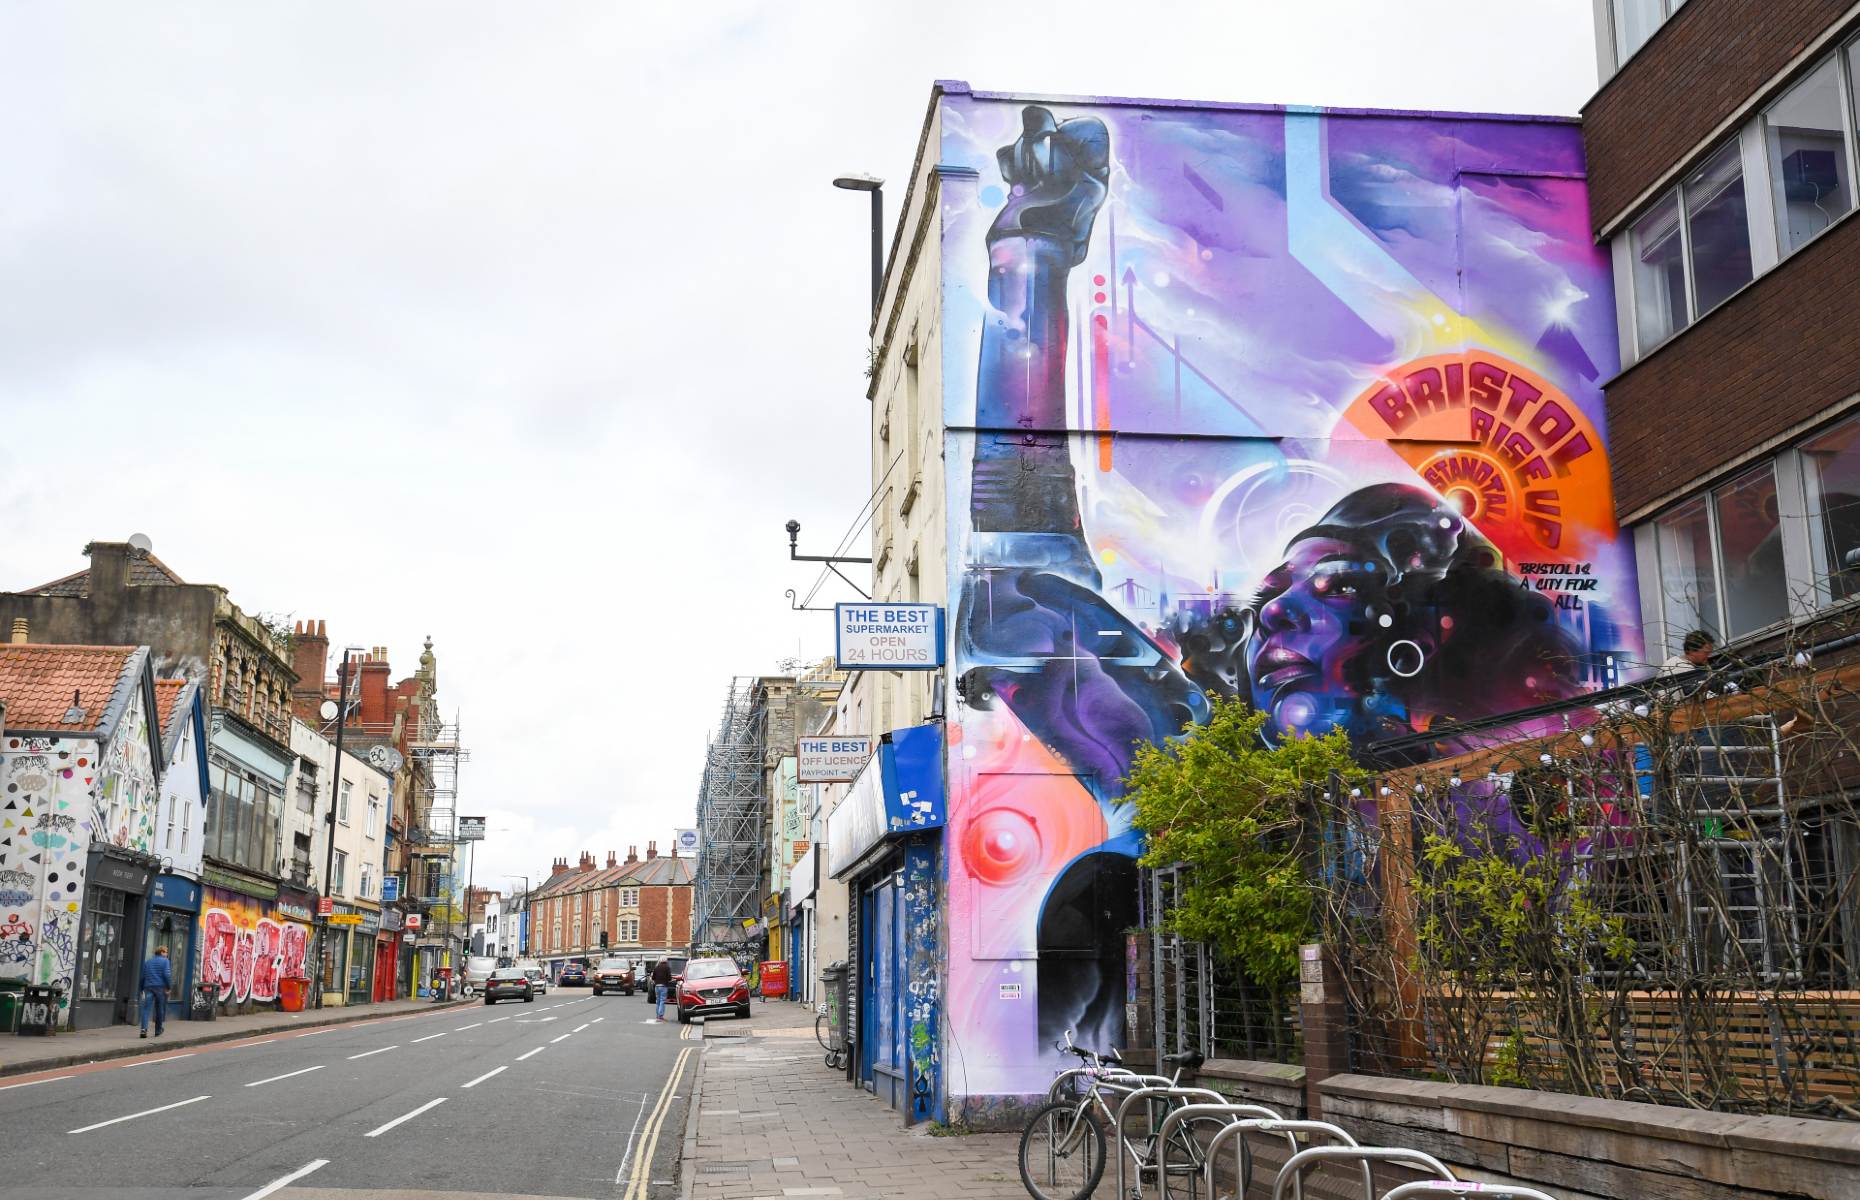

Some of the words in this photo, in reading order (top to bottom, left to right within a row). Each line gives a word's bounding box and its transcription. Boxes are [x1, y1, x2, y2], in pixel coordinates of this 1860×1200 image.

[1368, 361, 1593, 478] BRISTOL
[1470, 406, 1553, 488] RISE
[1521, 488, 1562, 550] UP
[1518, 562, 1573, 575] BRISTOL
[1575, 562, 1592, 575] IS
[1520, 576, 1530, 590] A
[1535, 578, 1563, 590] CITY
[1565, 578, 1598, 591] FOR
[1554, 594, 1583, 610] ALL
[846, 610, 879, 623] THE
[884, 610, 929, 623] BEST
[846, 624, 929, 634] SUPERMARKET
[869, 636, 906, 647] OPEN
[848, 648, 866, 661] 24
[871, 648, 928, 661] HOURS
[801, 742, 828, 753] THE
[832, 742, 867, 752] BEST
[802, 757, 822, 766] OFF
[824, 756, 867, 765] LICENCE
[801, 768, 838, 777] PAYPOINT
